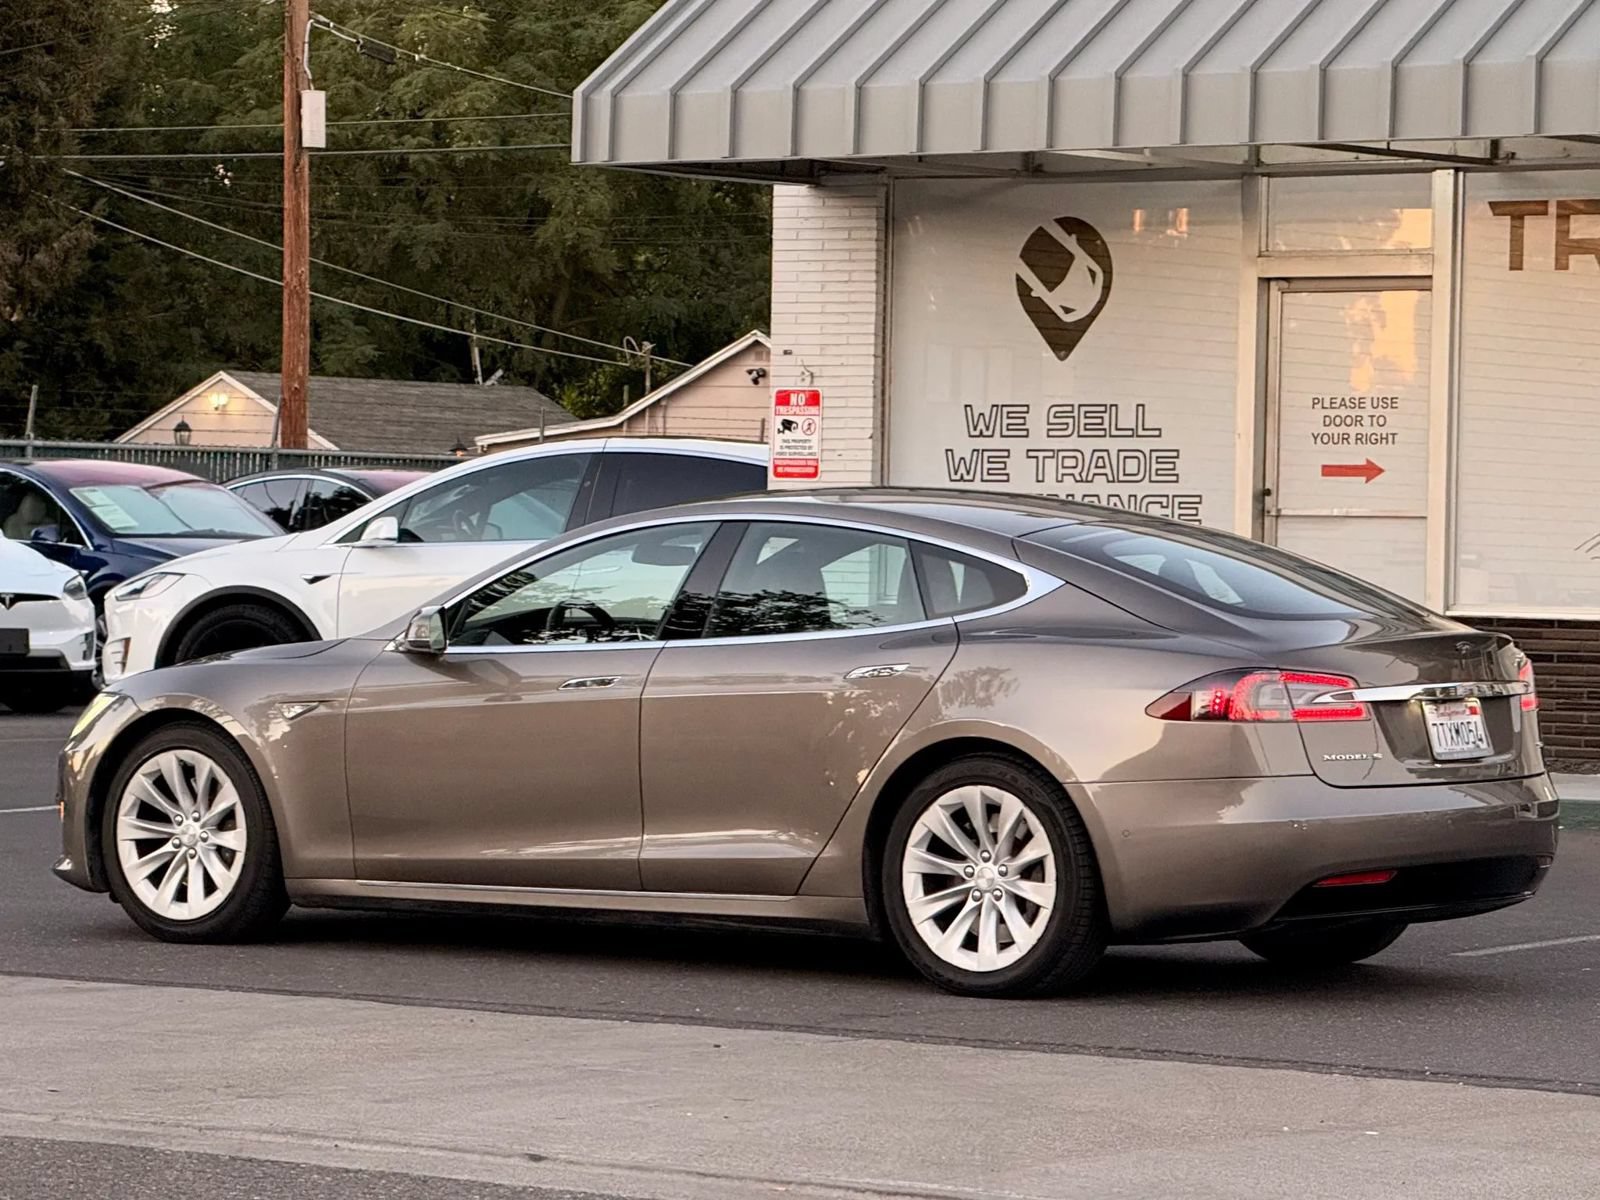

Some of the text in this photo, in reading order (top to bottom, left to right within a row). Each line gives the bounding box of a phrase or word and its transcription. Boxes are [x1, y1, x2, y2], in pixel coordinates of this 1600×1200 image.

[790, 392, 806, 406] NO
[1311, 396, 1399, 410] PLEASE USE
[964, 404, 1162, 438] WE SELL
[1322, 414, 1387, 428] DOOR TO
[1311, 432, 1398, 445] YOUR RIGHT
[945, 449, 1180, 483] WE TRADE
[1431, 721, 1484, 748] 7TXM054
